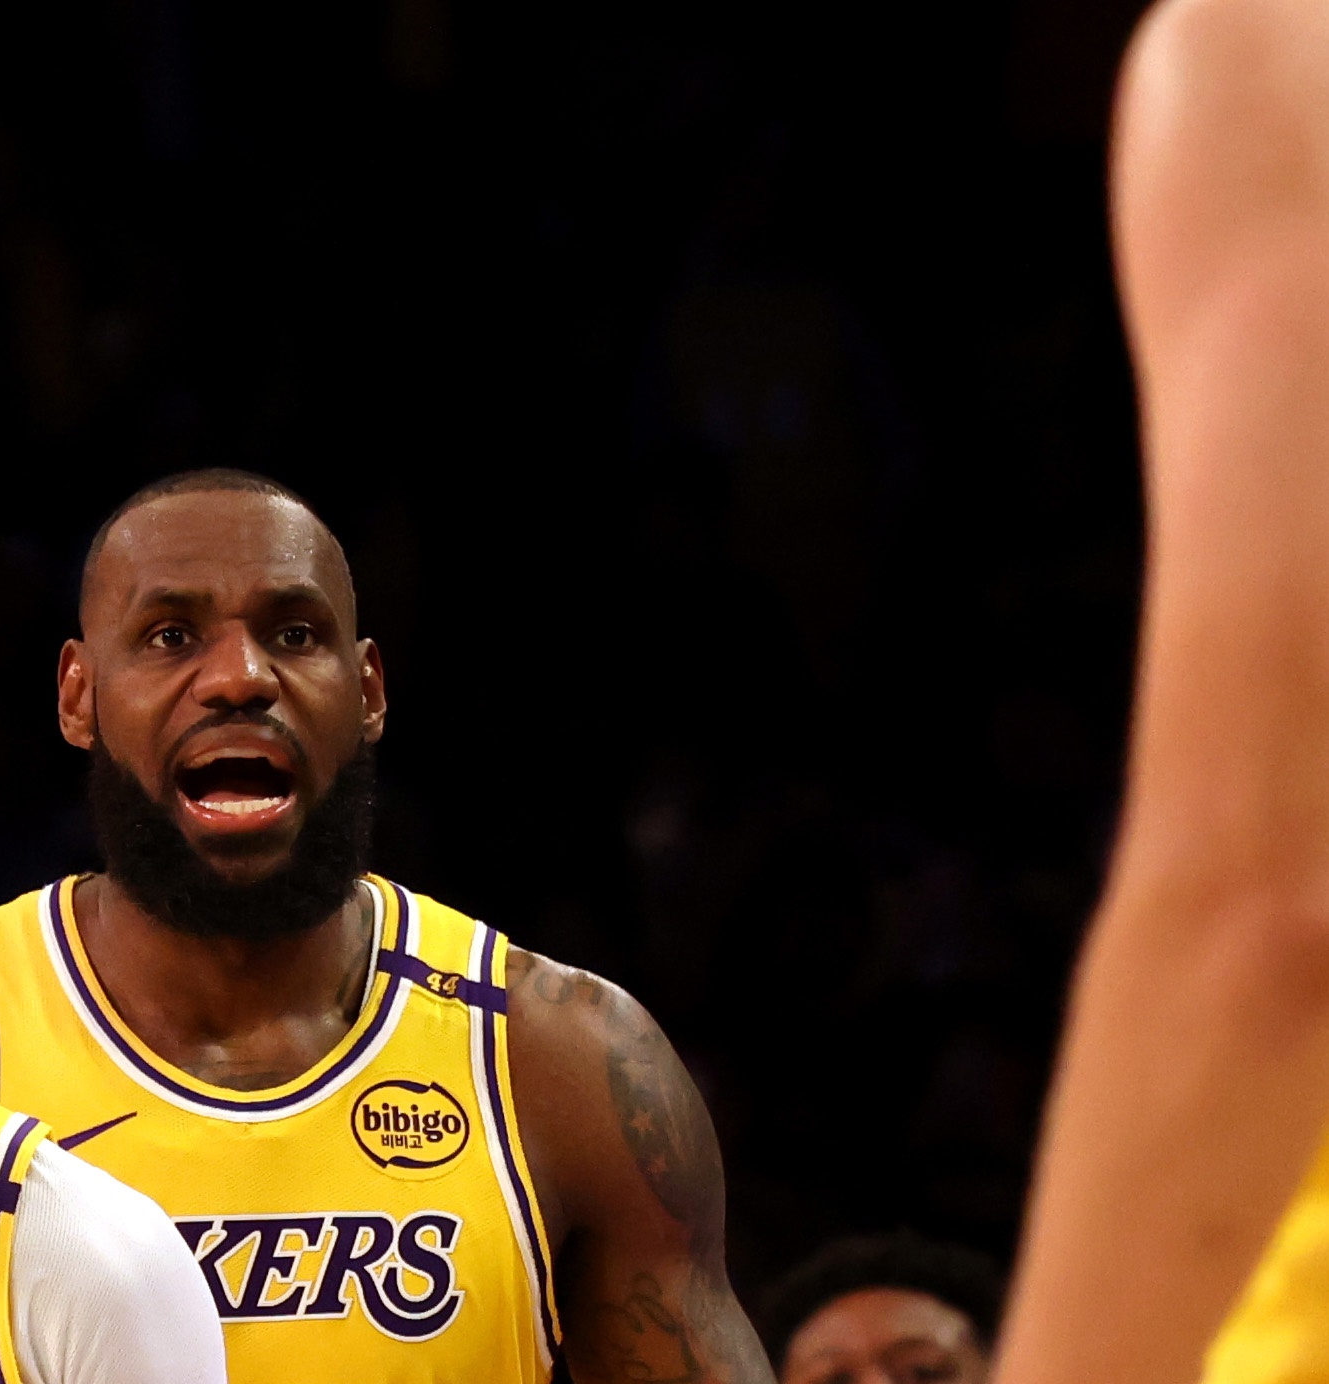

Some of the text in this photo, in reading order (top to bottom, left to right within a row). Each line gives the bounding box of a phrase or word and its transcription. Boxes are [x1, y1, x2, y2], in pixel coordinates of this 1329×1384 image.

[426, 972, 459, 995] 44
[362, 1102, 461, 1143] bibigo
[381, 1134, 423, 1149] 비비고
